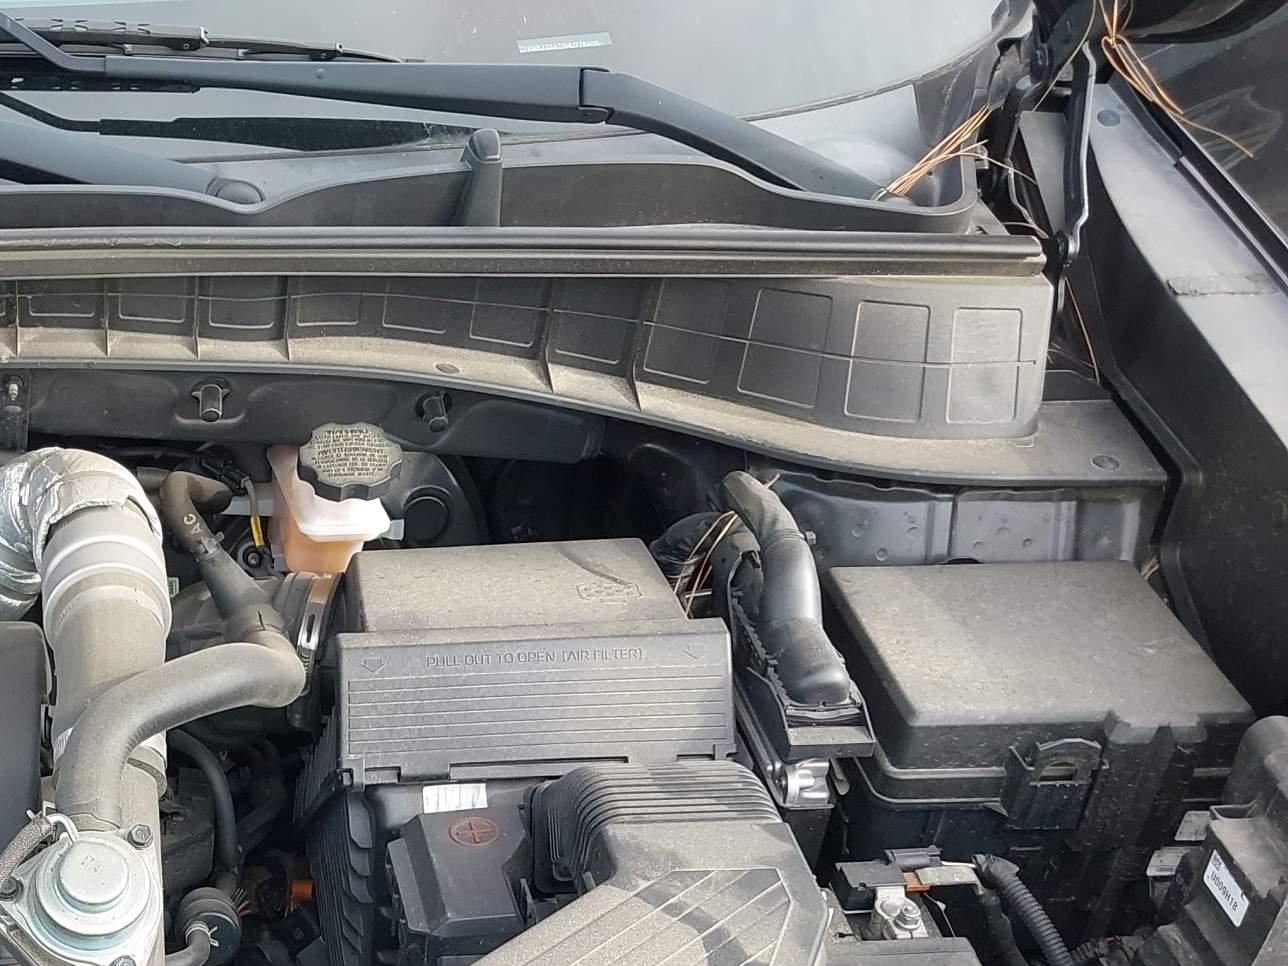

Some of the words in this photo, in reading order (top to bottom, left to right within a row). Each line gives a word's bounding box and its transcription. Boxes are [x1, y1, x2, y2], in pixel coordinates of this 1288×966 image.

[426, 655, 461, 668] PULL
[464, 653, 491, 666] OUT
[496, 652, 514, 665] TO
[517, 650, 555, 663] OPEN
